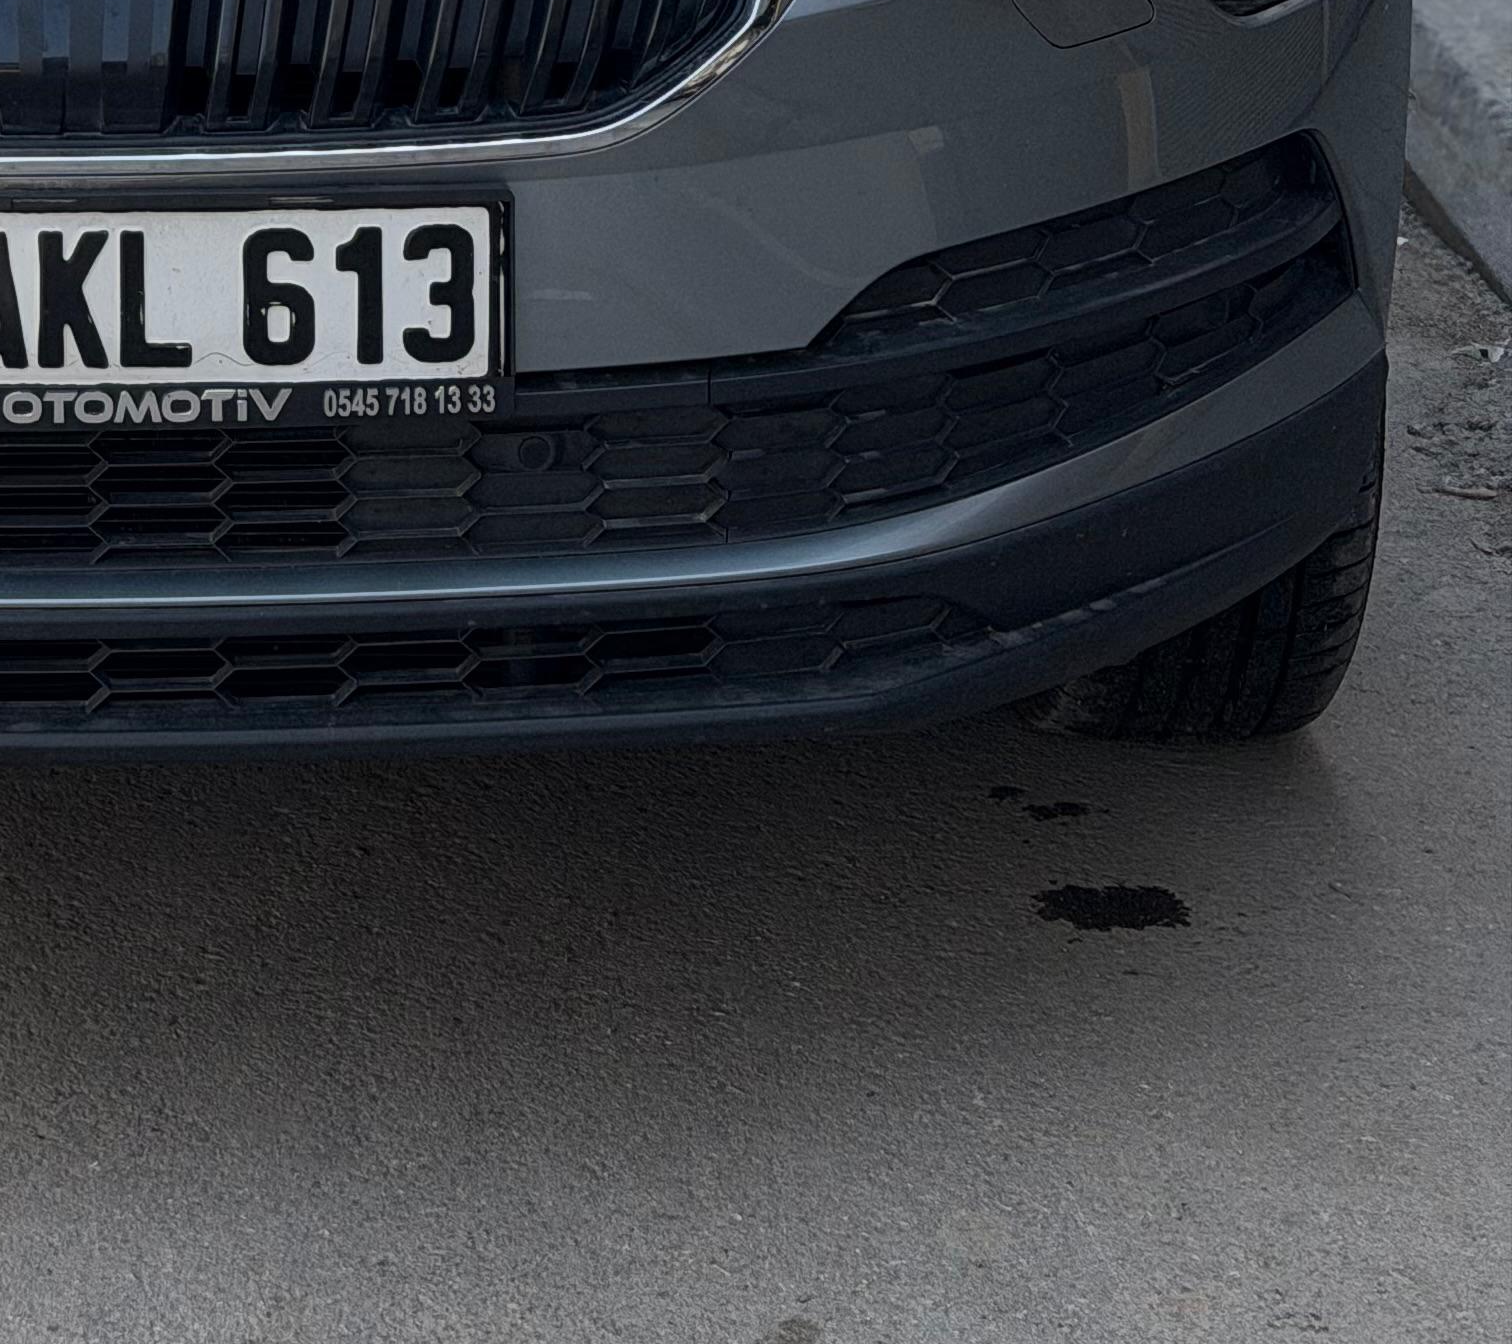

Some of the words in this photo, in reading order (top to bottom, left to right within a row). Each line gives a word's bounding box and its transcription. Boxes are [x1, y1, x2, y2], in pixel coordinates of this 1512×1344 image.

[242, 223, 476, 366] 613
[323, 387, 380, 417] 0545
[385, 386, 427, 416] 718
[434, 385, 462, 414] 13
[467, 384, 496, 413] 33
